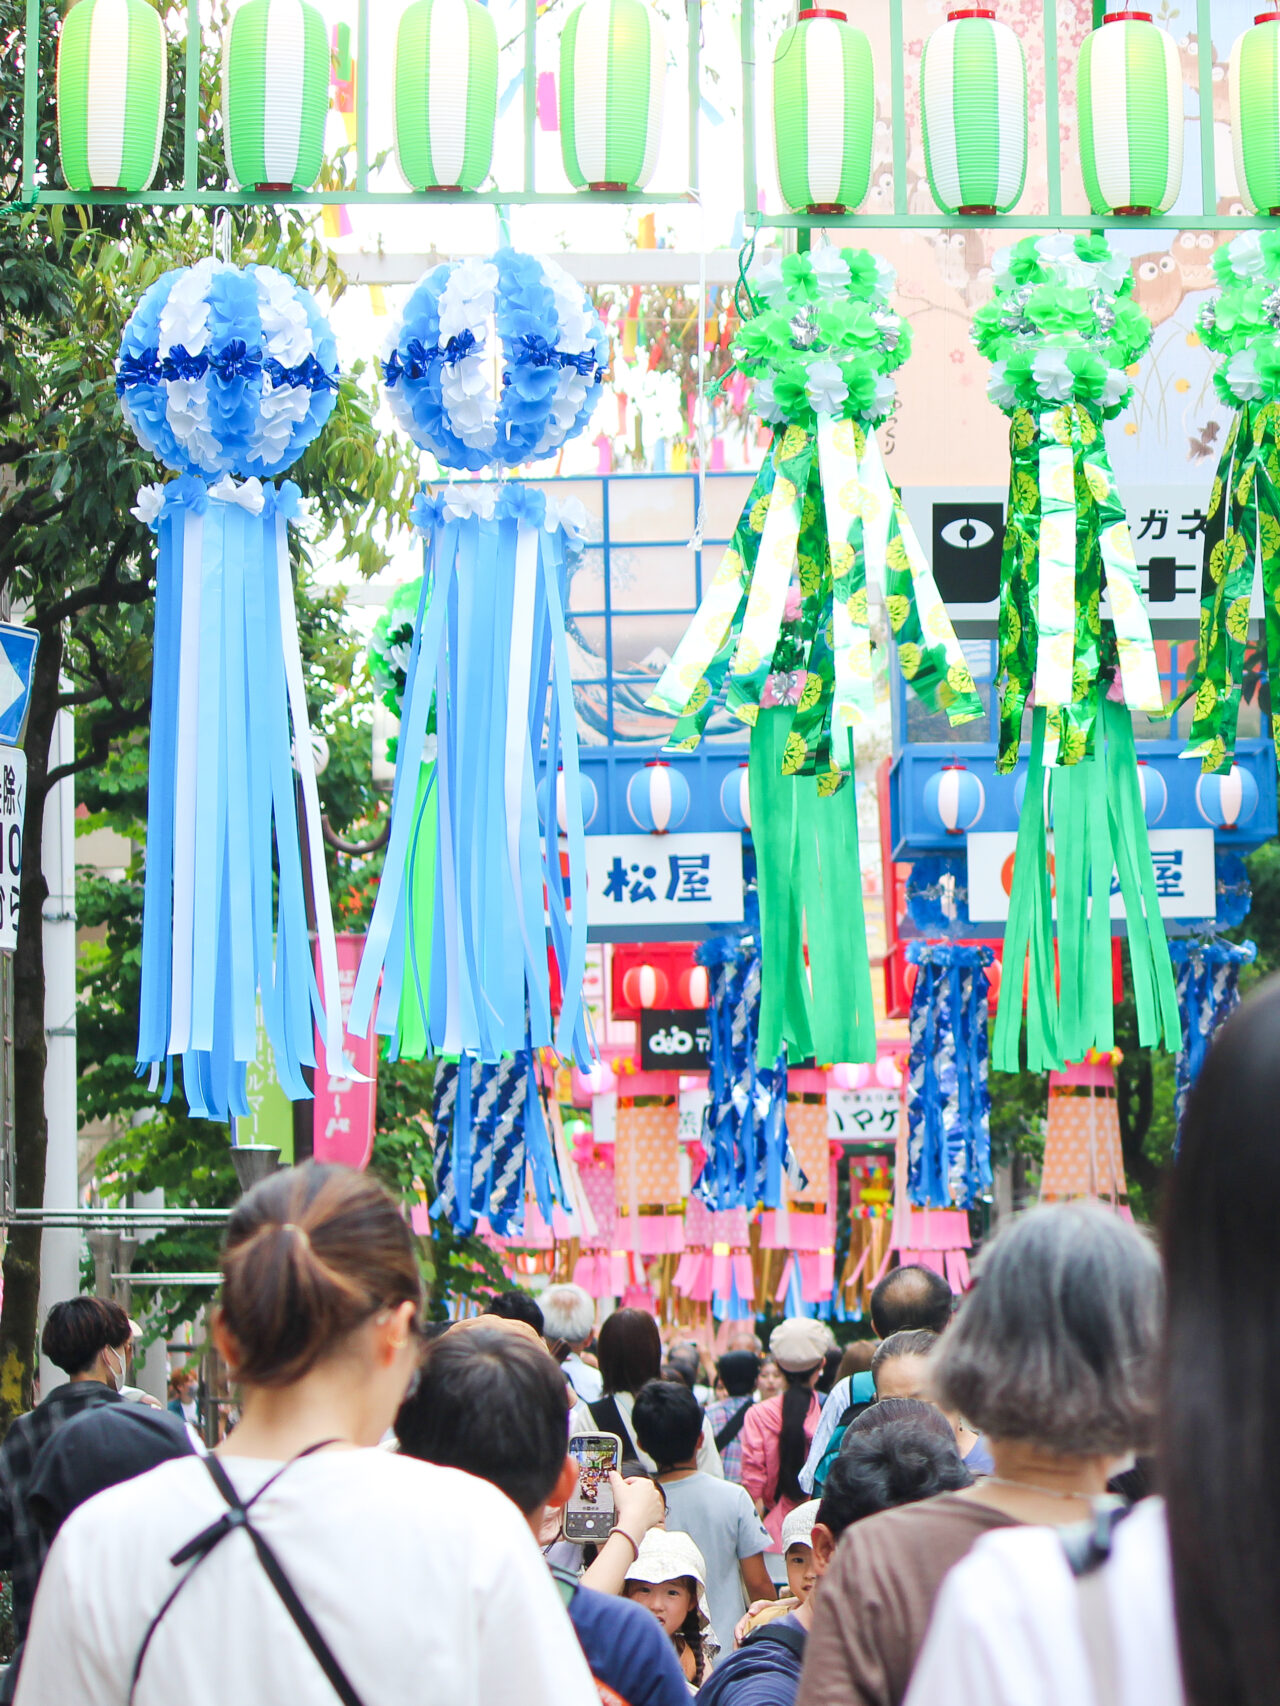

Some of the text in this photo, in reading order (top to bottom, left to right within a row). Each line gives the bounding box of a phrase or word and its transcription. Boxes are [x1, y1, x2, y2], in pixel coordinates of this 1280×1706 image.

[1123, 508, 1208, 540] ガネ
[0, 764, 23, 816] 除く
[602, 854, 713, 903] 松屋
